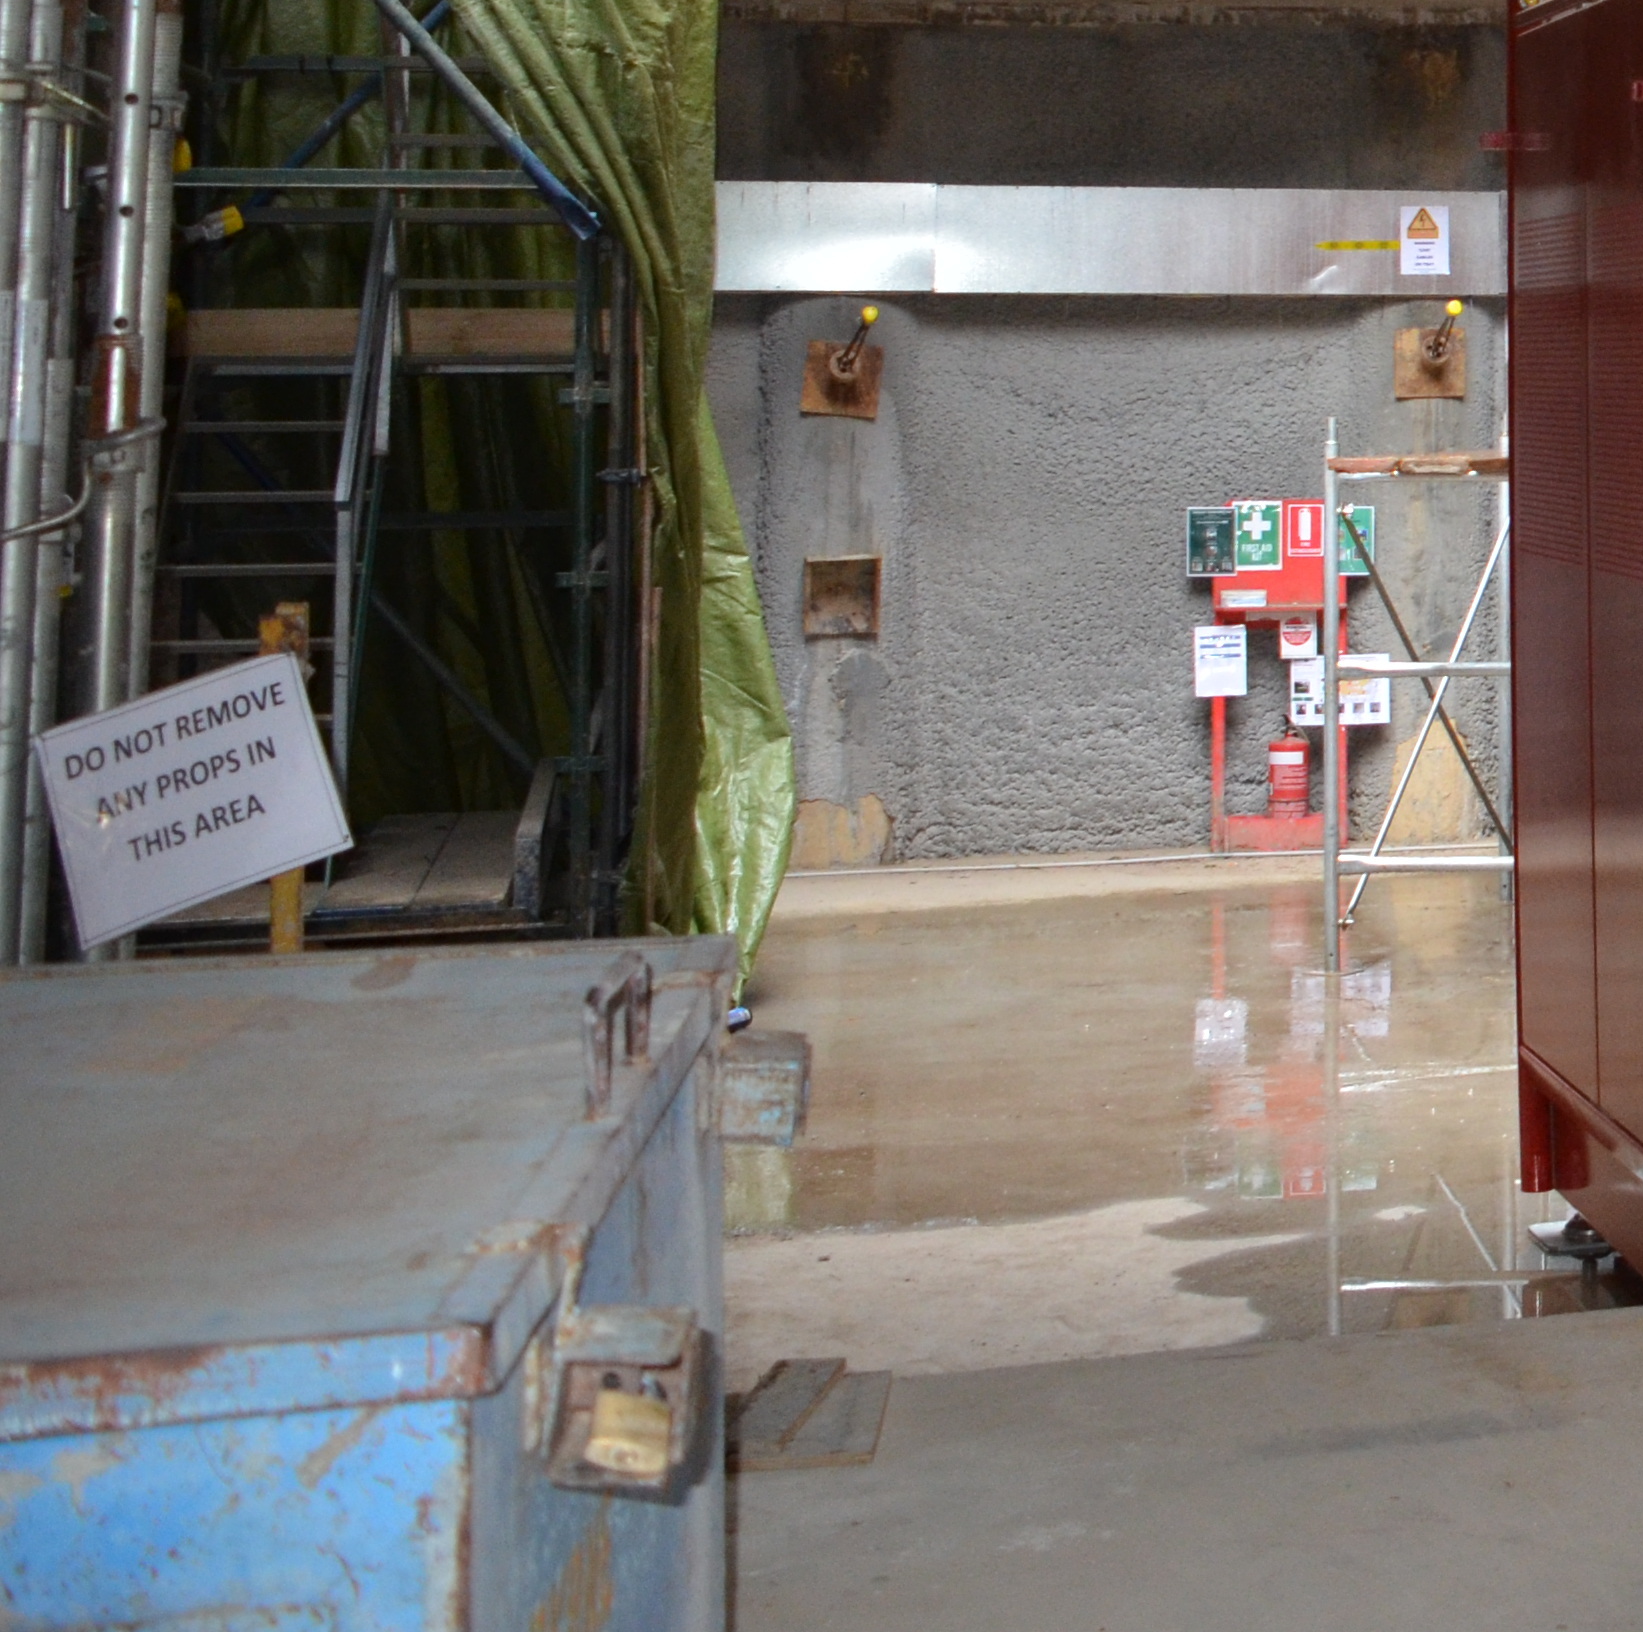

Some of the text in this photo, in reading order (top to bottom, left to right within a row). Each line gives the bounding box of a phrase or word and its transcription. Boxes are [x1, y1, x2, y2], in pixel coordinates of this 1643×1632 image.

[1262, 544, 1273, 552] AID
[64, 682, 286, 781] DO NOT REMOVE
[97, 736, 278, 823] ANY PROPS IN
[128, 794, 267, 862] THIS AREA
